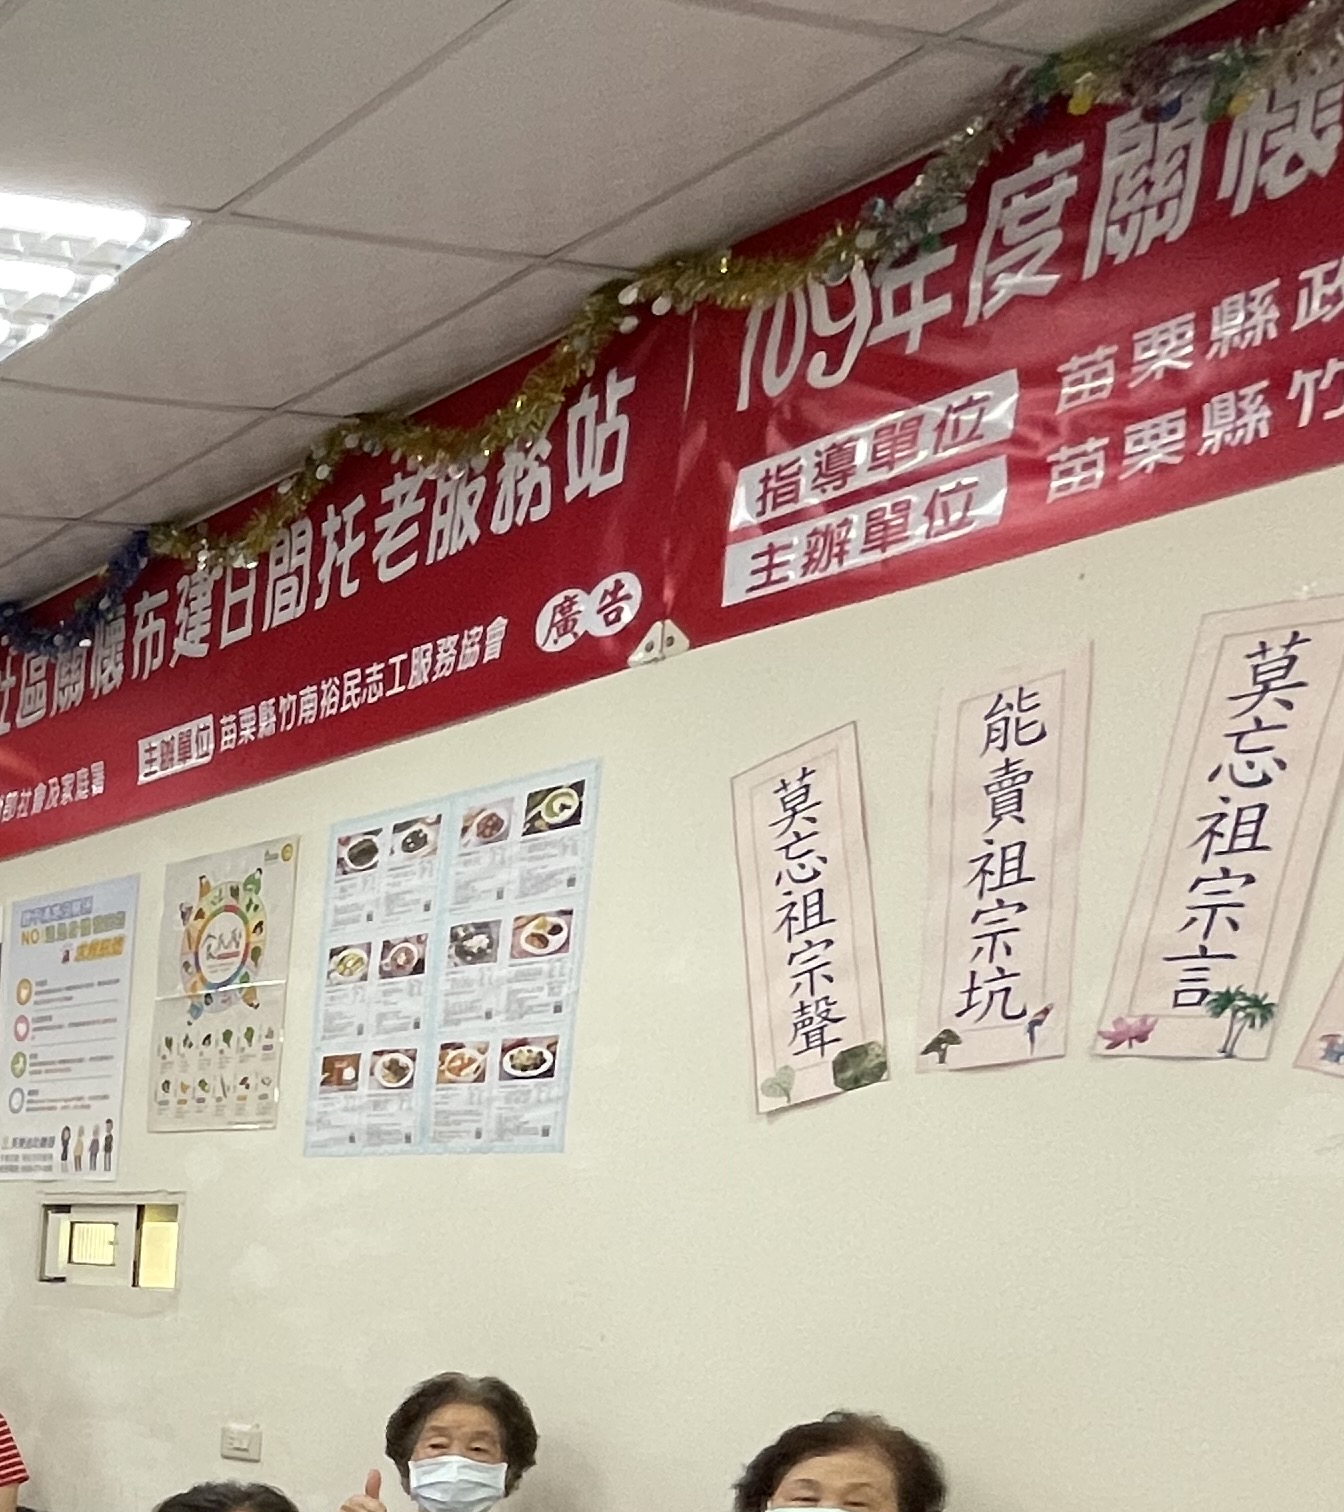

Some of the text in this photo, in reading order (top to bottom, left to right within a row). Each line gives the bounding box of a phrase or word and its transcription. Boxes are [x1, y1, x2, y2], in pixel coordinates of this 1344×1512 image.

[755, 389, 991, 517] 指導單位
[746, 476, 979, 595] 主辦單位
[542, 578, 633, 647] 廣告
[143, 720, 212, 778] 主辦單位
[219, 615, 510, 753] 苗栗縣竹南裕民志工服務協會
[955, 686, 1048, 1025] 能賣祖宗坑
[1162, 630, 1312, 1010] 莫忘祖宗言
[768, 766, 847, 1059] 莫忘祖宗聲
